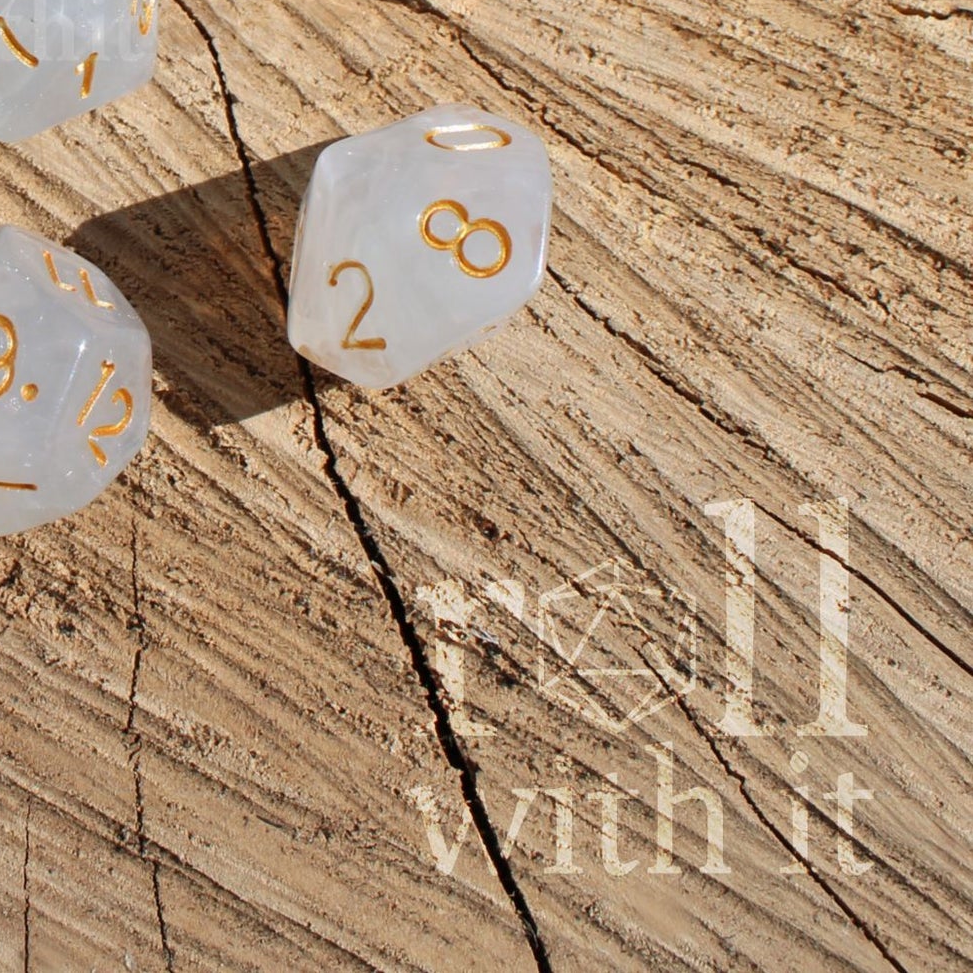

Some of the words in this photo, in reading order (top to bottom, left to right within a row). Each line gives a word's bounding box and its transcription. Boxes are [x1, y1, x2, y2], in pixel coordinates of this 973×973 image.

[75, 52, 99, 99] 1
[424, 123, 512, 151] 0
[418, 199, 512, 279] 8
[328, 258, 387, 350] 2
[77, 359, 133, 468] 12
